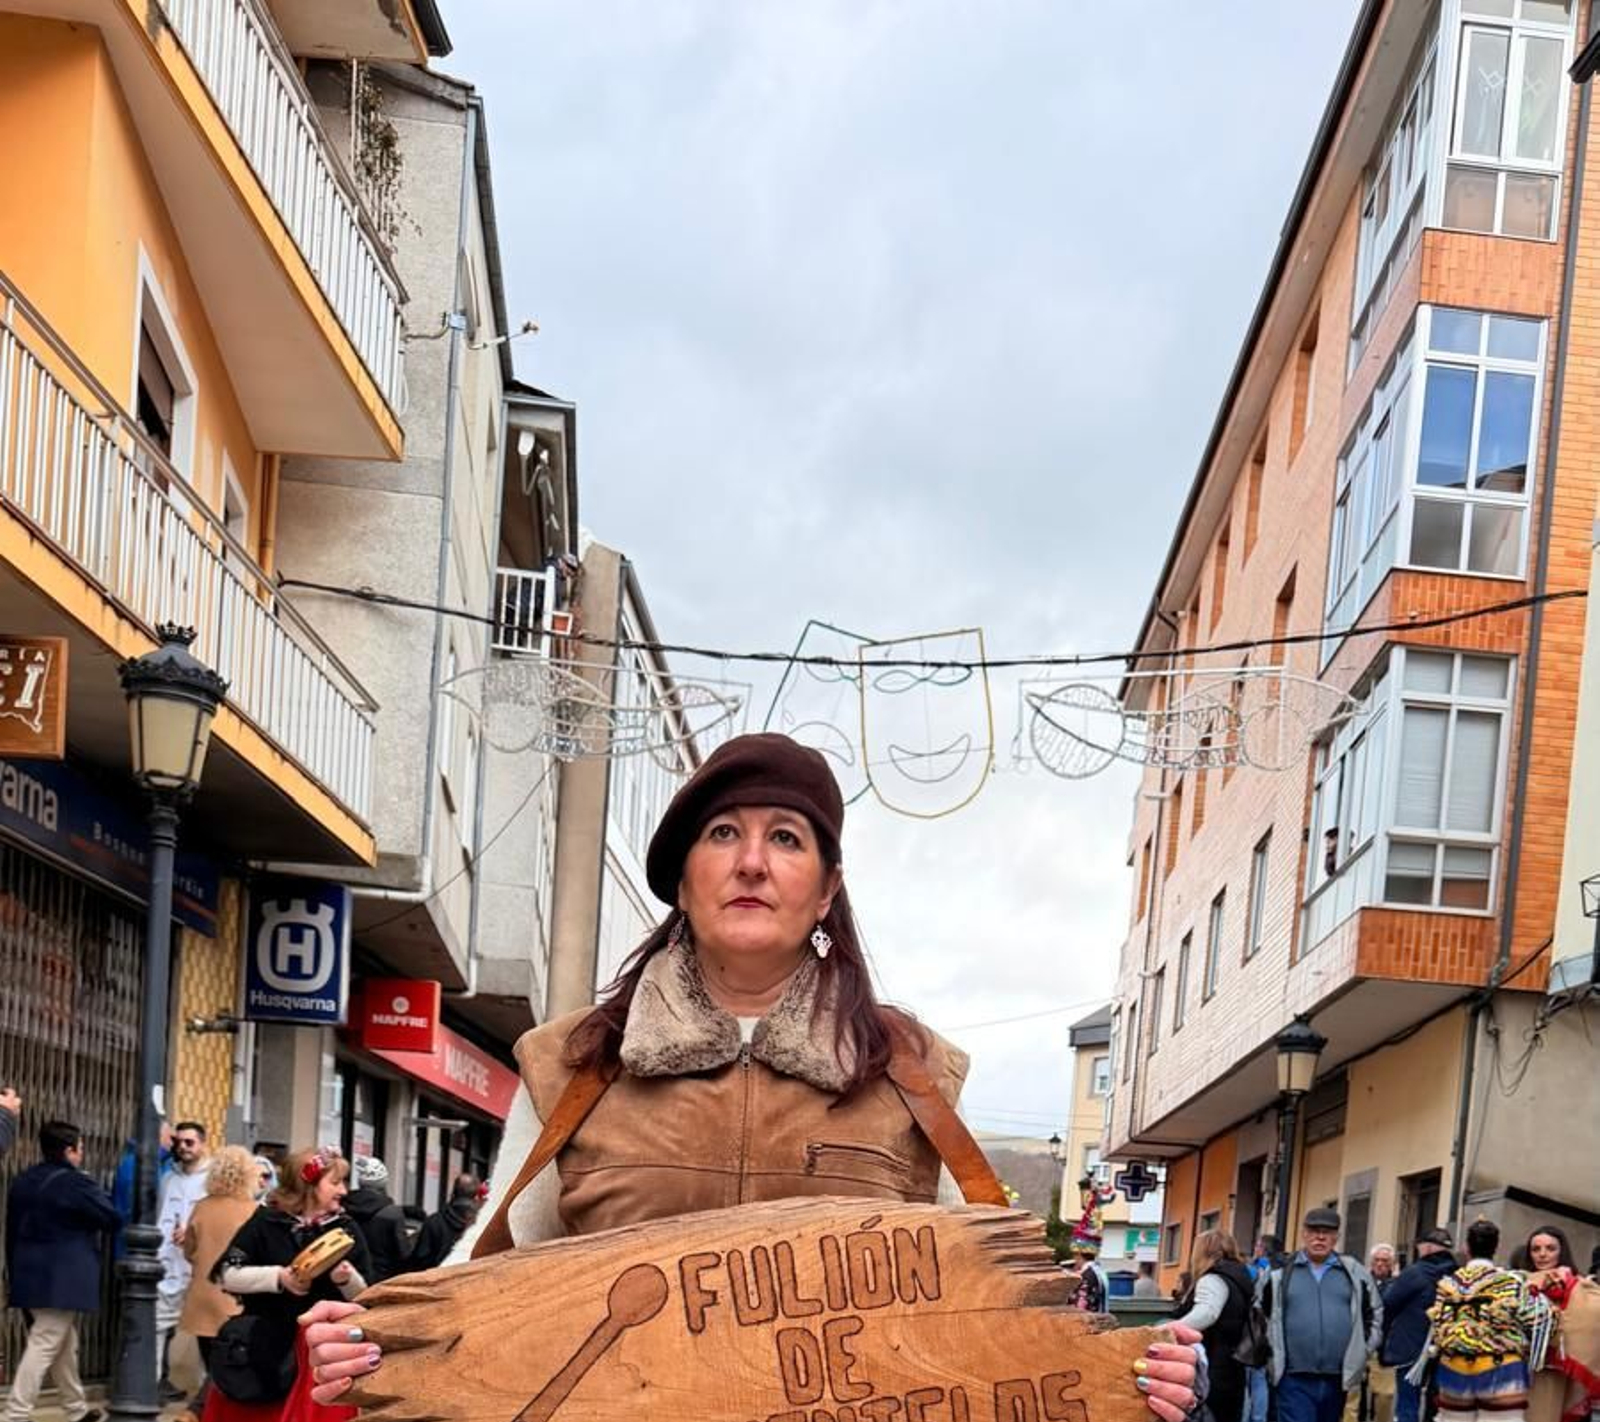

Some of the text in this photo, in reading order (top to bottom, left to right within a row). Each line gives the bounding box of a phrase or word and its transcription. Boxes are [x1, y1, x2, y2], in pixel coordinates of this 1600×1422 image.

[0, 760, 58, 832] arna
[250, 989, 336, 1012] Husqvarna
[372, 1014, 428, 1028] MAPFRE
[678, 1215, 941, 1334] FULIÓN
[776, 1315, 874, 1406] DE
